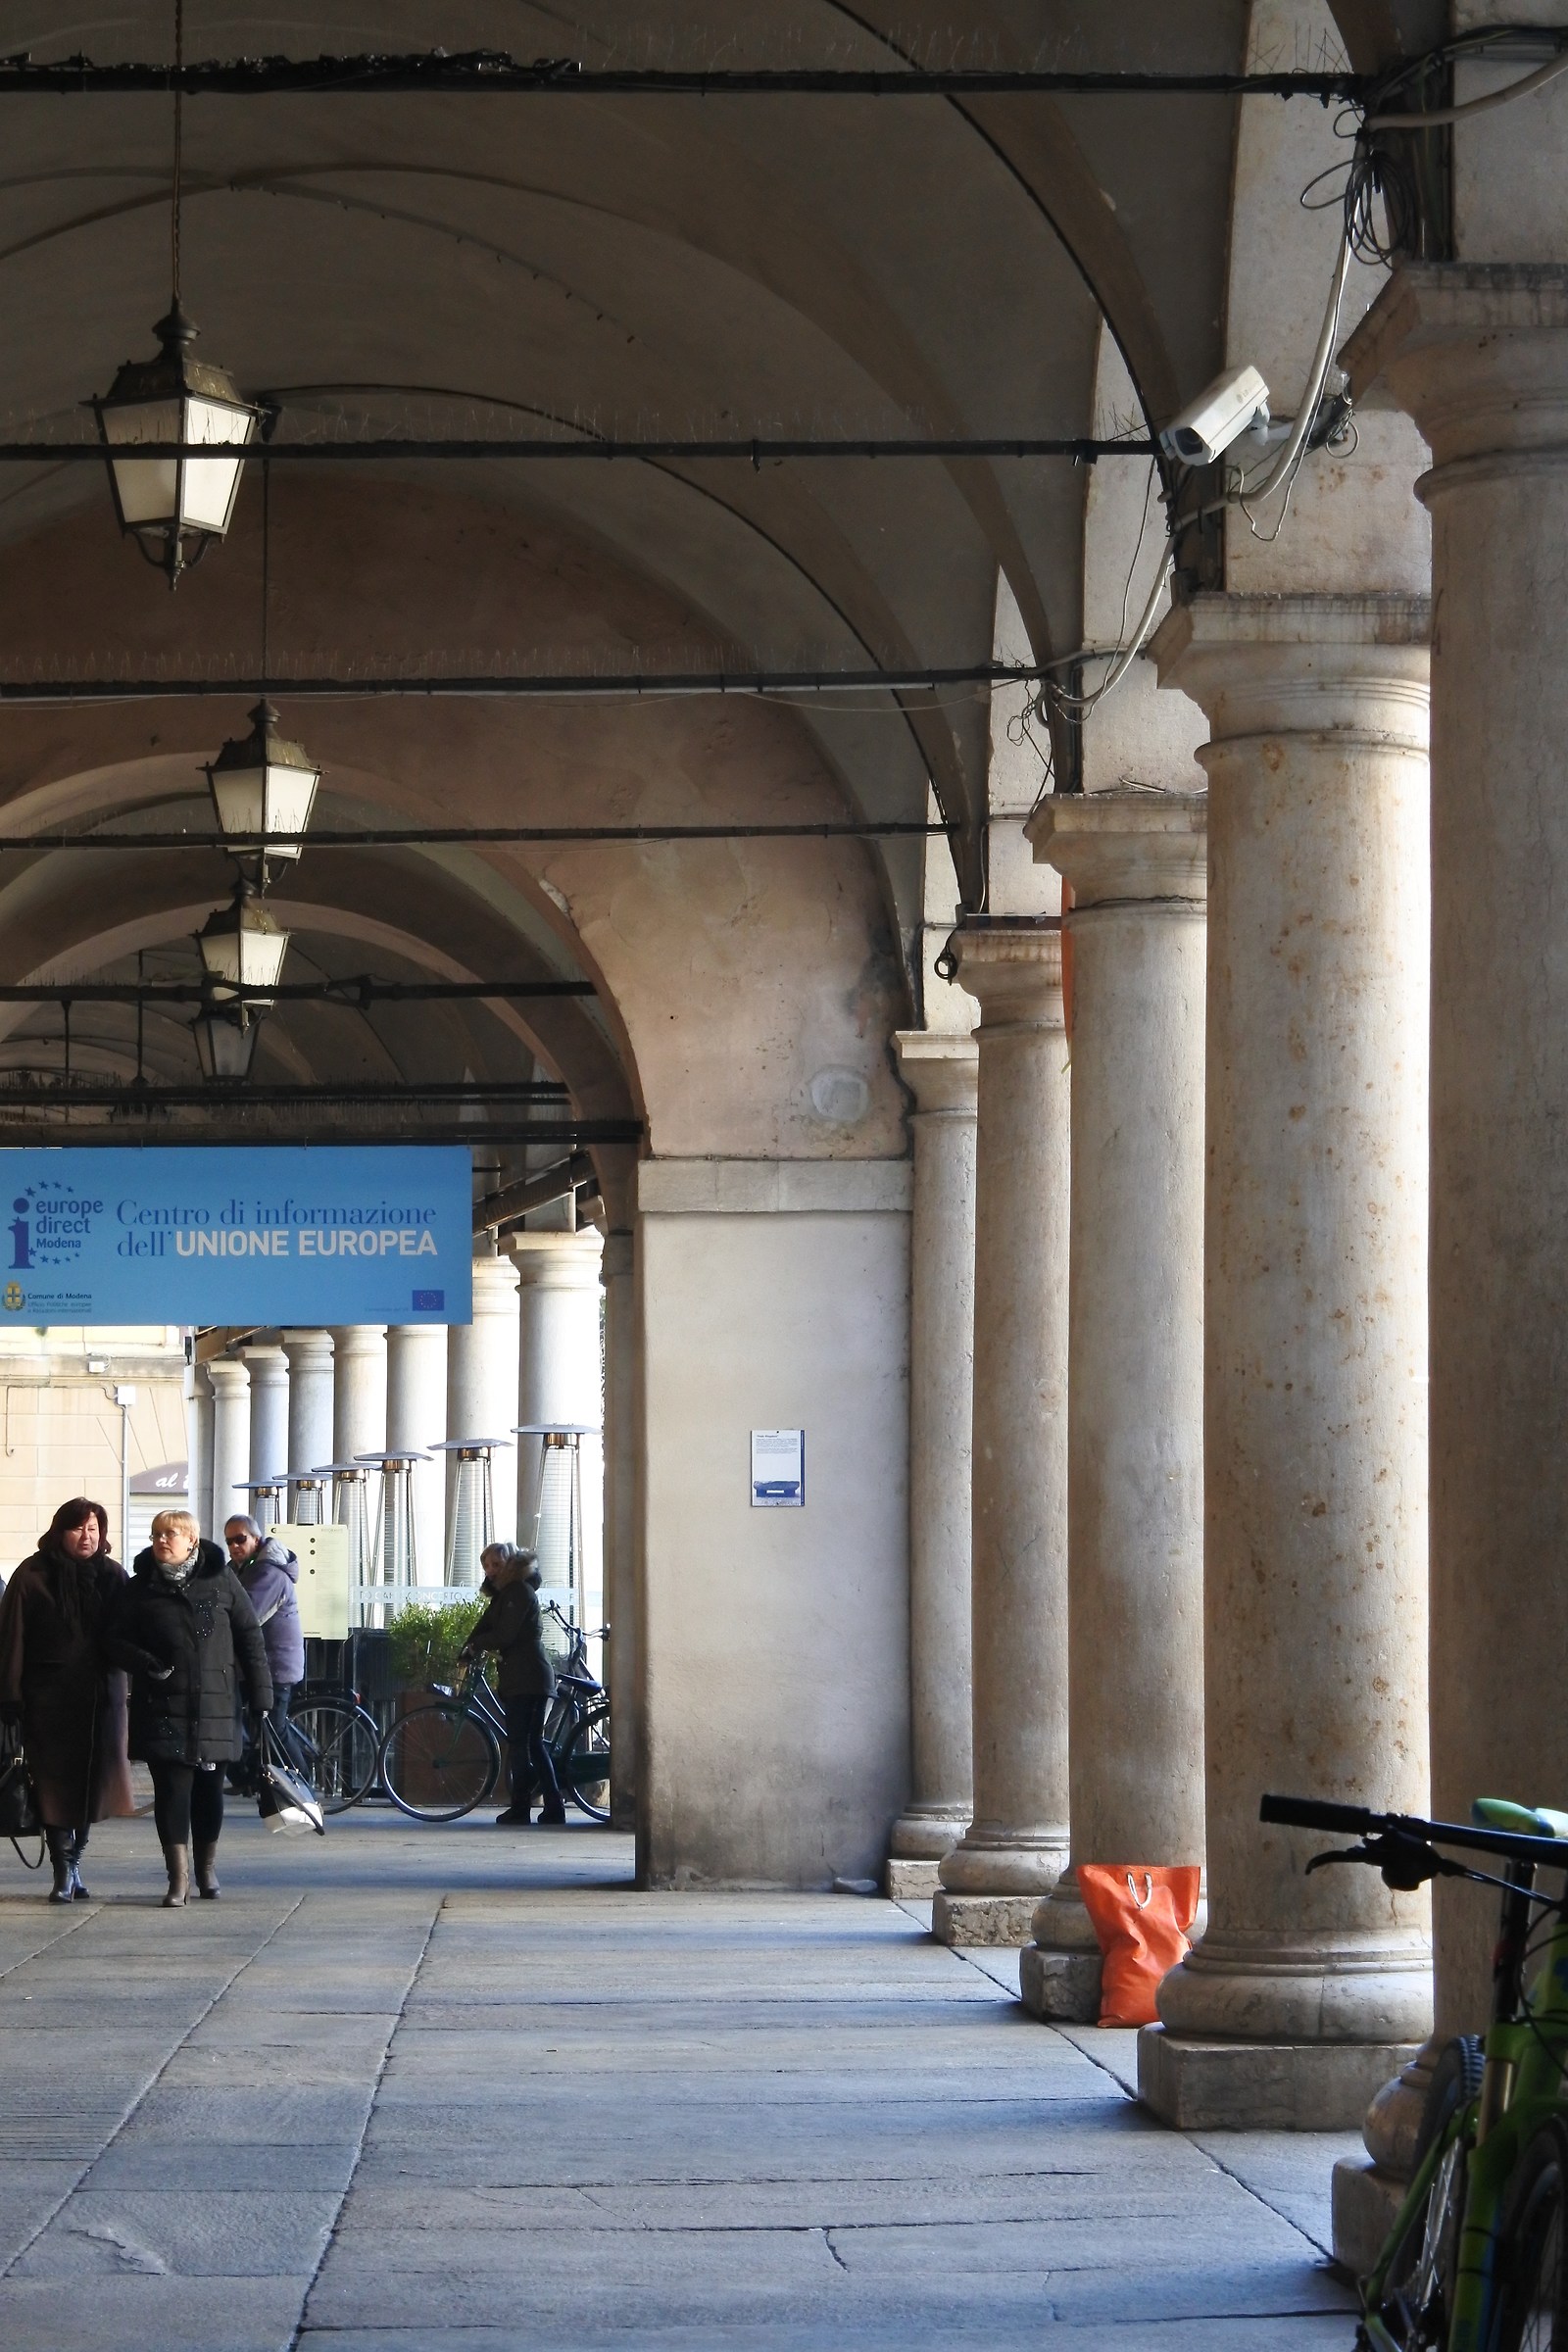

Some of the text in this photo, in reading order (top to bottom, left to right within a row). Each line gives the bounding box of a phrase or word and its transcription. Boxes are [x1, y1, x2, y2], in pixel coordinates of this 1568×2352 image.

[36, 1200, 104, 1218] europe
[117, 1199, 437, 1225] Centro di informazione
[36, 1215, 91, 1234] direct
[36, 1237, 81, 1249] Modena
[299, 1230, 438, 1255] EUROPEA
[156, 1473, 178, 1488] al
